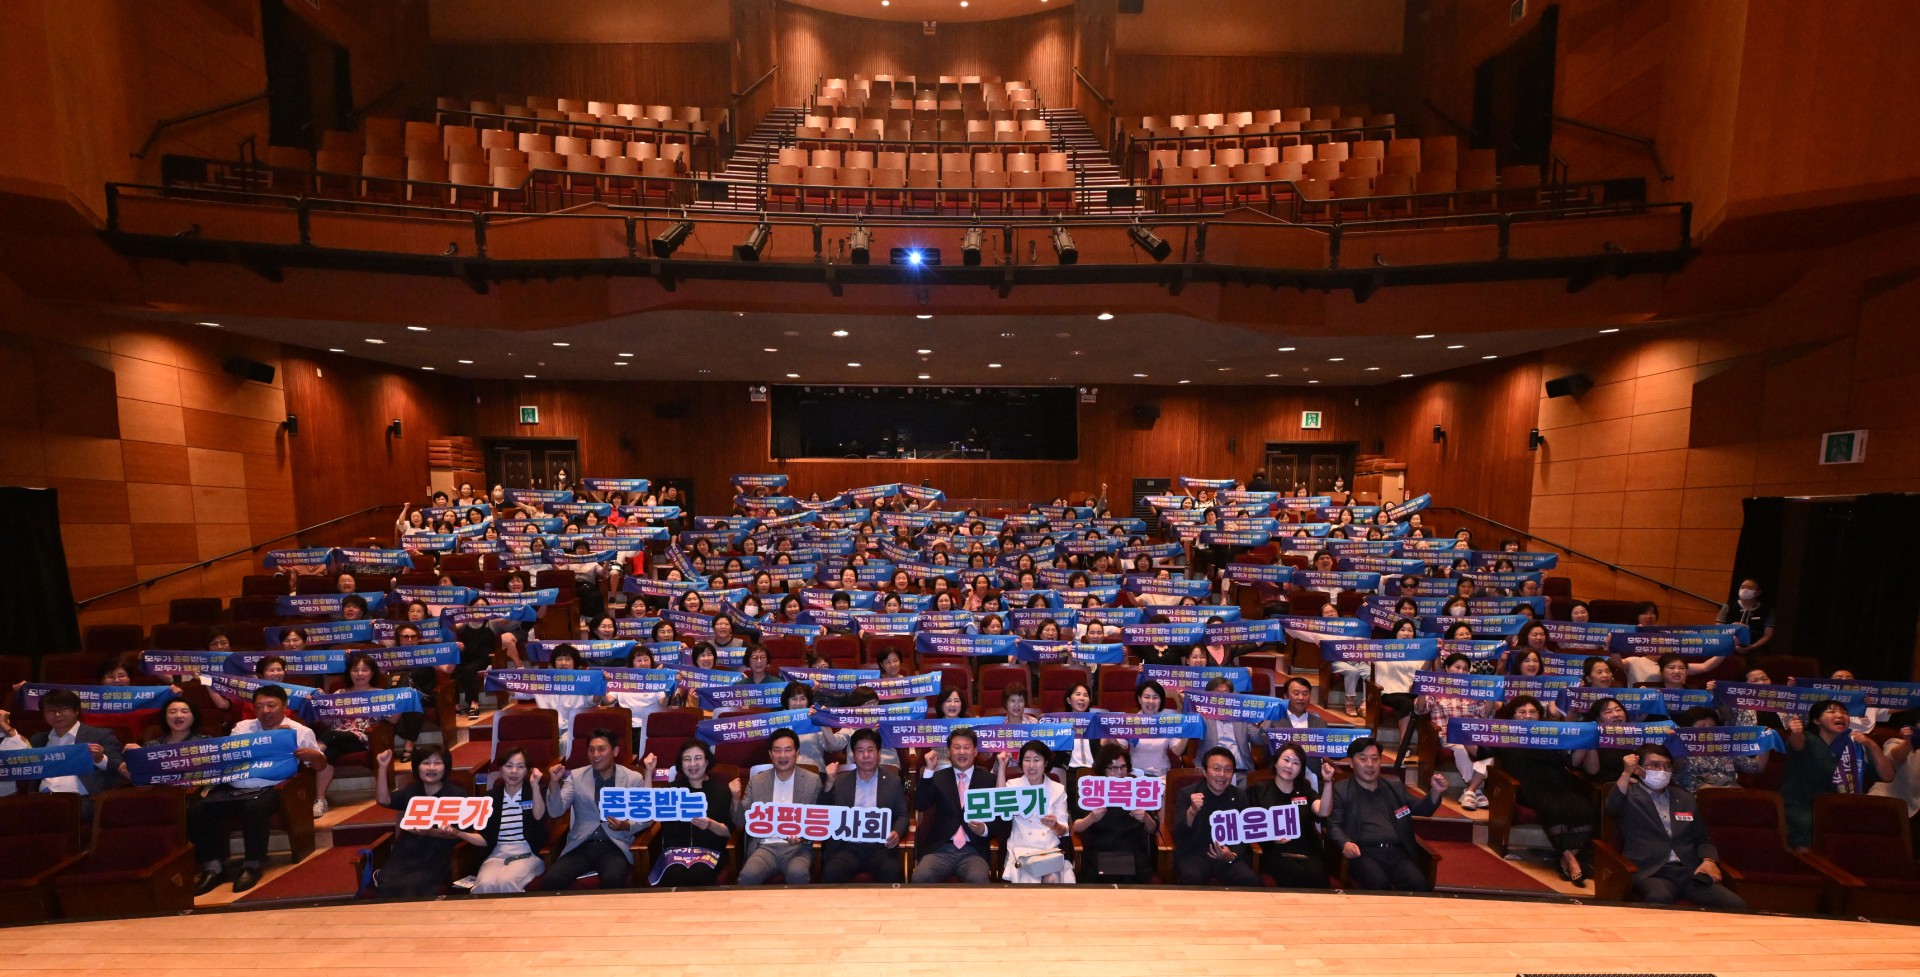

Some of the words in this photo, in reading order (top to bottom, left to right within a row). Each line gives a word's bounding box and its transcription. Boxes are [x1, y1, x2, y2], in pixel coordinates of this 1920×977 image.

[1171, 627, 1190, 635] 성평등
[1151, 635, 1170, 643] 행복한
[1627, 636, 1649, 644] 모두가
[1650, 637, 1680, 645] 존중받는
[1681, 637, 1703, 645] 성평등
[1335, 643, 1355, 651] 모두가
[1356, 643, 1383, 651] 존중받는
[1406, 642, 1420, 650] 사회
[1635, 646, 1657, 654] 모두가
[1658, 646, 1680, 654] 행복한
[1681, 646, 1703, 654] 해운대
[383, 649, 411, 659] 존중받는
[413, 648, 434, 657] 성평등
[1364, 651, 1384, 659] 행복한
[1385, 651, 1406, 659] 해운대
[144, 655, 171, 663] 모두가
[173, 655, 208, 663] 존중받는
[303, 655, 326, 663] 성평등
[392, 659, 415, 667] 행복한
[305, 663, 328, 671] 해운대
[522, 673, 551, 681] 존중받는
[553, 673, 574, 681] 성평등
[645, 673, 666, 681] 성평등
[1148, 669, 1170, 677] 모두가
[1171, 670, 1200, 679] 존중받는
[1201, 671, 1223, 679] 성평등
[1224, 671, 1238, 679] 사회
[623, 681, 644, 690] 행복한
[646, 682, 666, 690] 해운대
[880, 678, 910, 688] 존중받는
[911, 674, 931, 684] 성평등
[1437, 676, 1469, 686] 존중받는
[1470, 678, 1495, 687] 성평등
[530, 682, 552, 690] 행복한
[553, 683, 575, 691] 해운대
[889, 687, 911, 695] 행복한
[912, 685, 933, 693] 해운대
[1420, 685, 1443, 693] 모두가
[1444, 687, 1469, 696] 행복한
[1470, 688, 1495, 697] 해운대
[1880, 687, 1909, 695] 성평등
[102, 691, 132, 700] 성평등
[134, 691, 154, 699] 사회
[311, 698, 334, 708] 모두가
[335, 696, 369, 706] 존중받는
[370, 694, 395, 702] 성평등
[396, 691, 412, 700] 사회
[1726, 687, 1756, 697] 모두가
[1757, 689, 1797, 699] 존중받는
[1799, 692, 1829, 701] 성평등
[1831, 694, 1852, 703] 사회
[102, 701, 133, 710] 해운대
[1209, 695, 1241, 707] 존중받는
[1242, 699, 1265, 709] 성평등
[1736, 697, 1766, 707] 모두가
[1767, 699, 1796, 709] 행복한
[1880, 697, 1908, 706] 해운대
[319, 708, 344, 716] 모두가
[345, 706, 371, 715] 행복한
[372, 703, 395, 713] 해운대
[830, 706, 854, 715] 모두가
[855, 706, 886, 715] 존중받는
[887, 705, 910, 714] 성평등
[912, 704, 927, 712] 사회
[1217, 707, 1241, 717] 행복한
[1242, 710, 1265, 719] 해운대
[713, 722, 736, 732] 모두가
[737, 718, 767, 729] 존중받는
[768, 715, 791, 725] 성평등
[792, 712, 808, 721] 사회
[1100, 717, 1124, 725] 모두가
[1125, 716, 1157, 725] 존중받는
[1158, 715, 1182, 724] 성평등
[1183, 715, 1199, 723] 사회
[892, 724, 916, 733] 모두가
[917, 724, 948, 733] 존중받는
[997, 729, 1029, 738] 존중받는
[1030, 728, 1054, 737] 성평등
[1056, 728, 1072, 737] 사회
[1109, 727, 1133, 735] 모두가
[1134, 726, 1158, 735] 행복한
[1159, 726, 1182, 734] 해운대
[1461, 722, 1489, 731] 모두가
[1490, 724, 1528, 733] 존중받는
[1529, 725, 1558, 735] 성평등
[1560, 727, 1580, 736] 사회
[1606, 726, 1643, 735] 존중받는
[723, 731, 746, 741] 모두가
[901, 735, 925, 744] 모두가
[1292, 732, 1324, 742] 존중받는
[1326, 732, 1350, 741] 성평등
[1471, 734, 1499, 743] 모두가
[1500, 734, 1529, 744] 행복한
[1530, 735, 1559, 745] 해운대
[1616, 736, 1644, 745] 행복한
[1697, 732, 1731, 741] 존중받는
[1732, 732, 1757, 740] 성평등
[147, 749, 177, 761] 모두가
[179, 743, 219, 757] 존중받는
[221, 738, 250, 750] 성평등
[252, 736, 272, 746] 사회
[981, 740, 1005, 748] 모두가
[1706, 744, 1731, 752] 행복한
[1732, 743, 1760, 751] 해운대
[7, 754, 41, 765] 성평등
[44, 753, 65, 762] 사회
[160, 758, 190, 770] 모두가
[191, 753, 221, 766] 행복한
[222, 750, 252, 761] 해운대
[11, 765, 43, 776] 해운대
[1081, 778, 1160, 807] 행복한
[602, 790, 704, 818] 존중받는
[967, 787, 1047, 820] 모두가
[404, 799, 490, 827] 모두가
[748, 805, 830, 837] 성평등
[835, 810, 888, 840] 사회
[1213, 807, 1298, 843] 해운대
